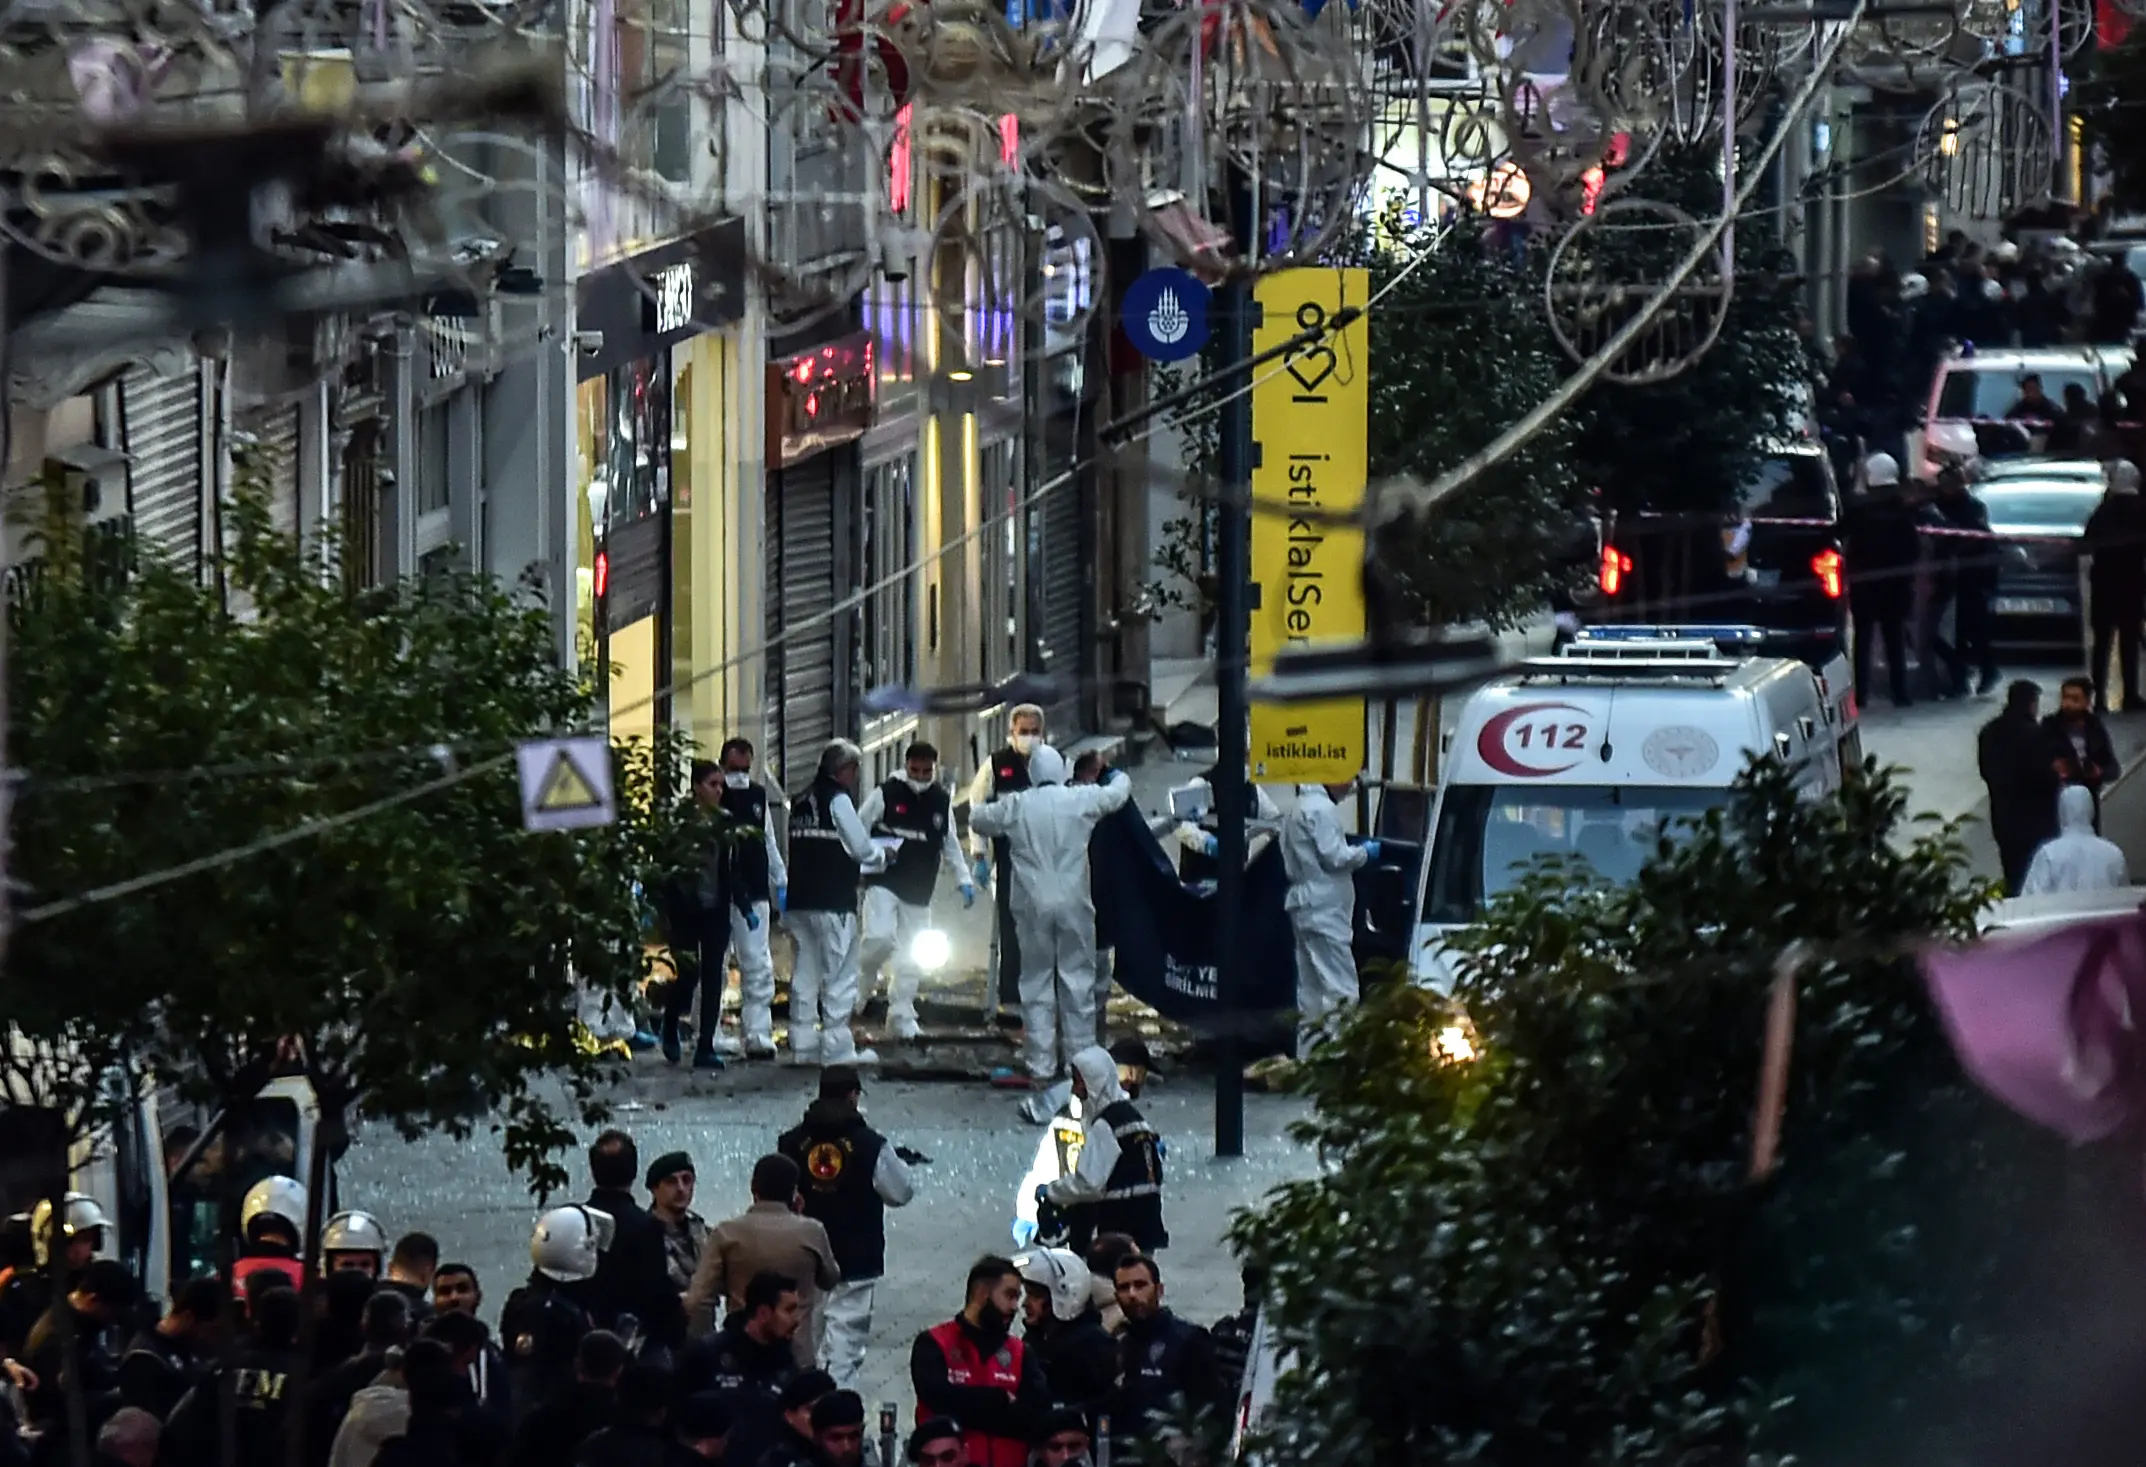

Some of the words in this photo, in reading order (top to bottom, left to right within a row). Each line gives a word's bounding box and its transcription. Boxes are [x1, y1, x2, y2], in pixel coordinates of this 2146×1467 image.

[1515, 723, 1586, 750] 112
[1266, 742, 1347, 760] istiklal.ist
[1164, 971, 1219, 1001] GİRİLME
